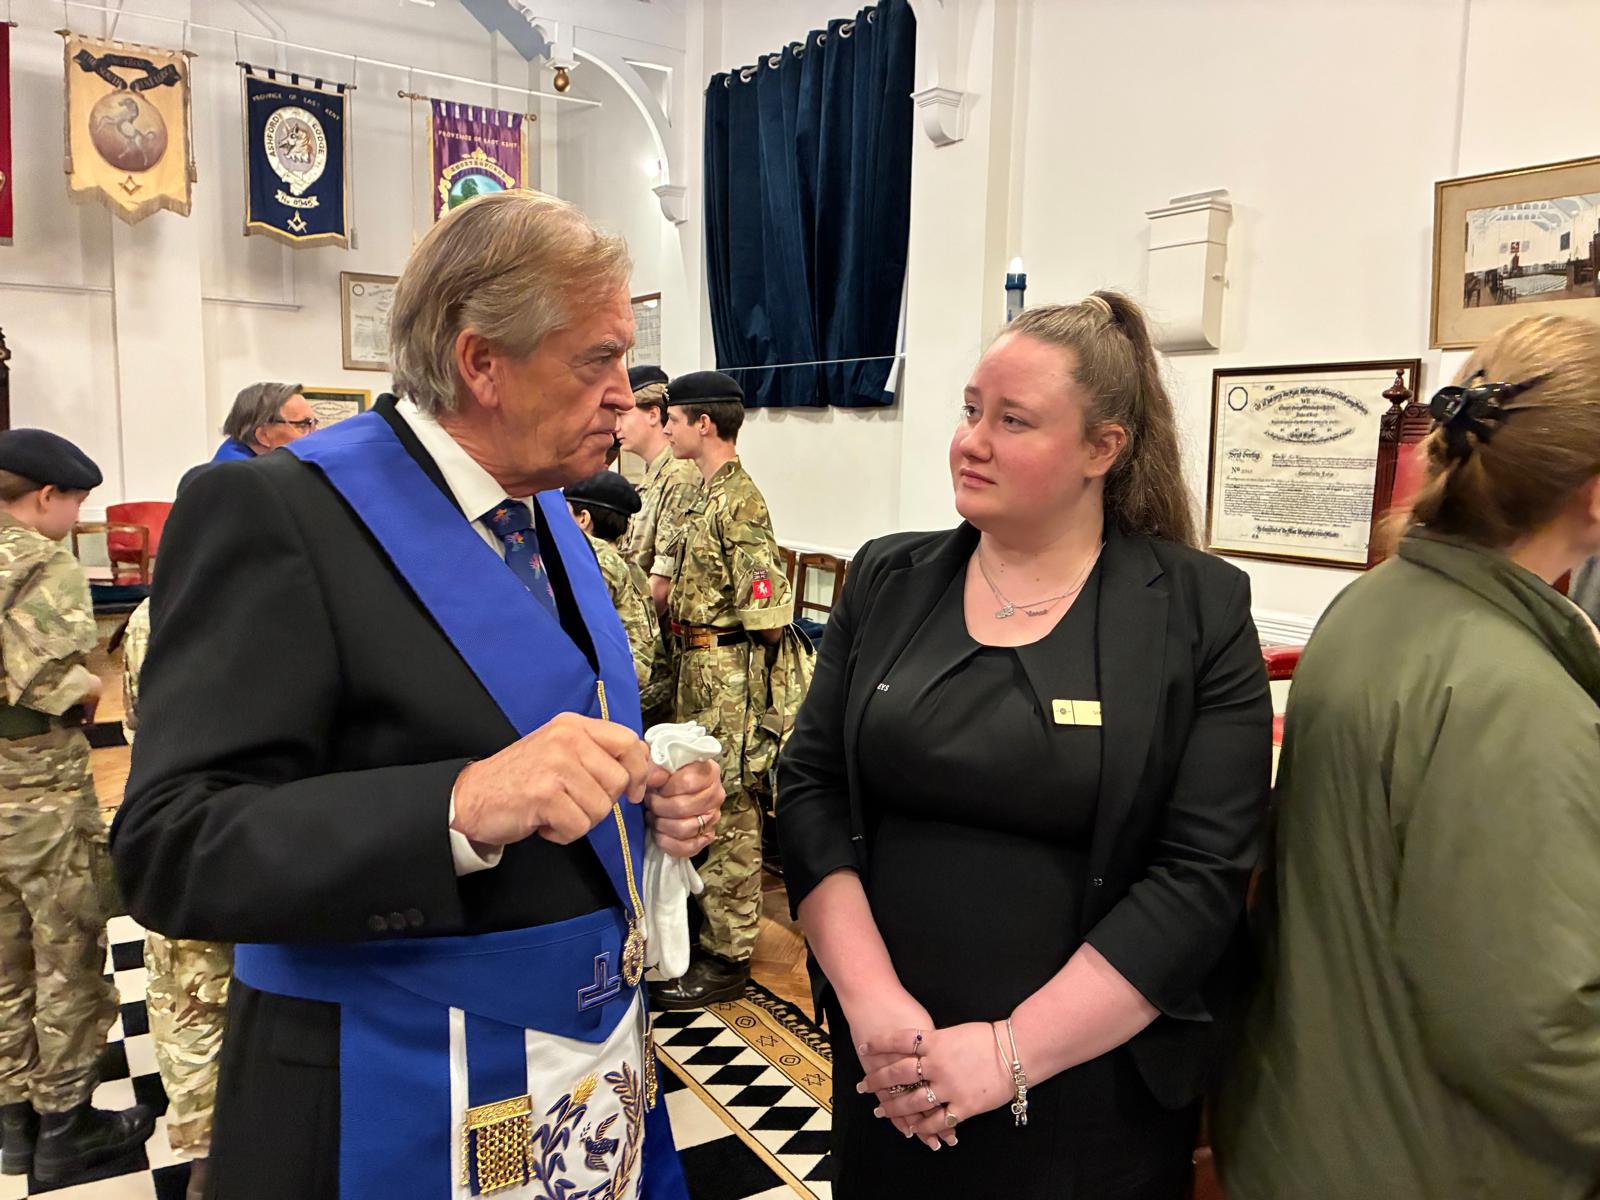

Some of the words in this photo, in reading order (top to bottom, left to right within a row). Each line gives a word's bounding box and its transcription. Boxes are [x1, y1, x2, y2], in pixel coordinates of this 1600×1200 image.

[266, 114, 280, 157] ASHFORD
[312, 123, 325, 155] LODGE
[438, 130, 472, 141] PROVINCE
